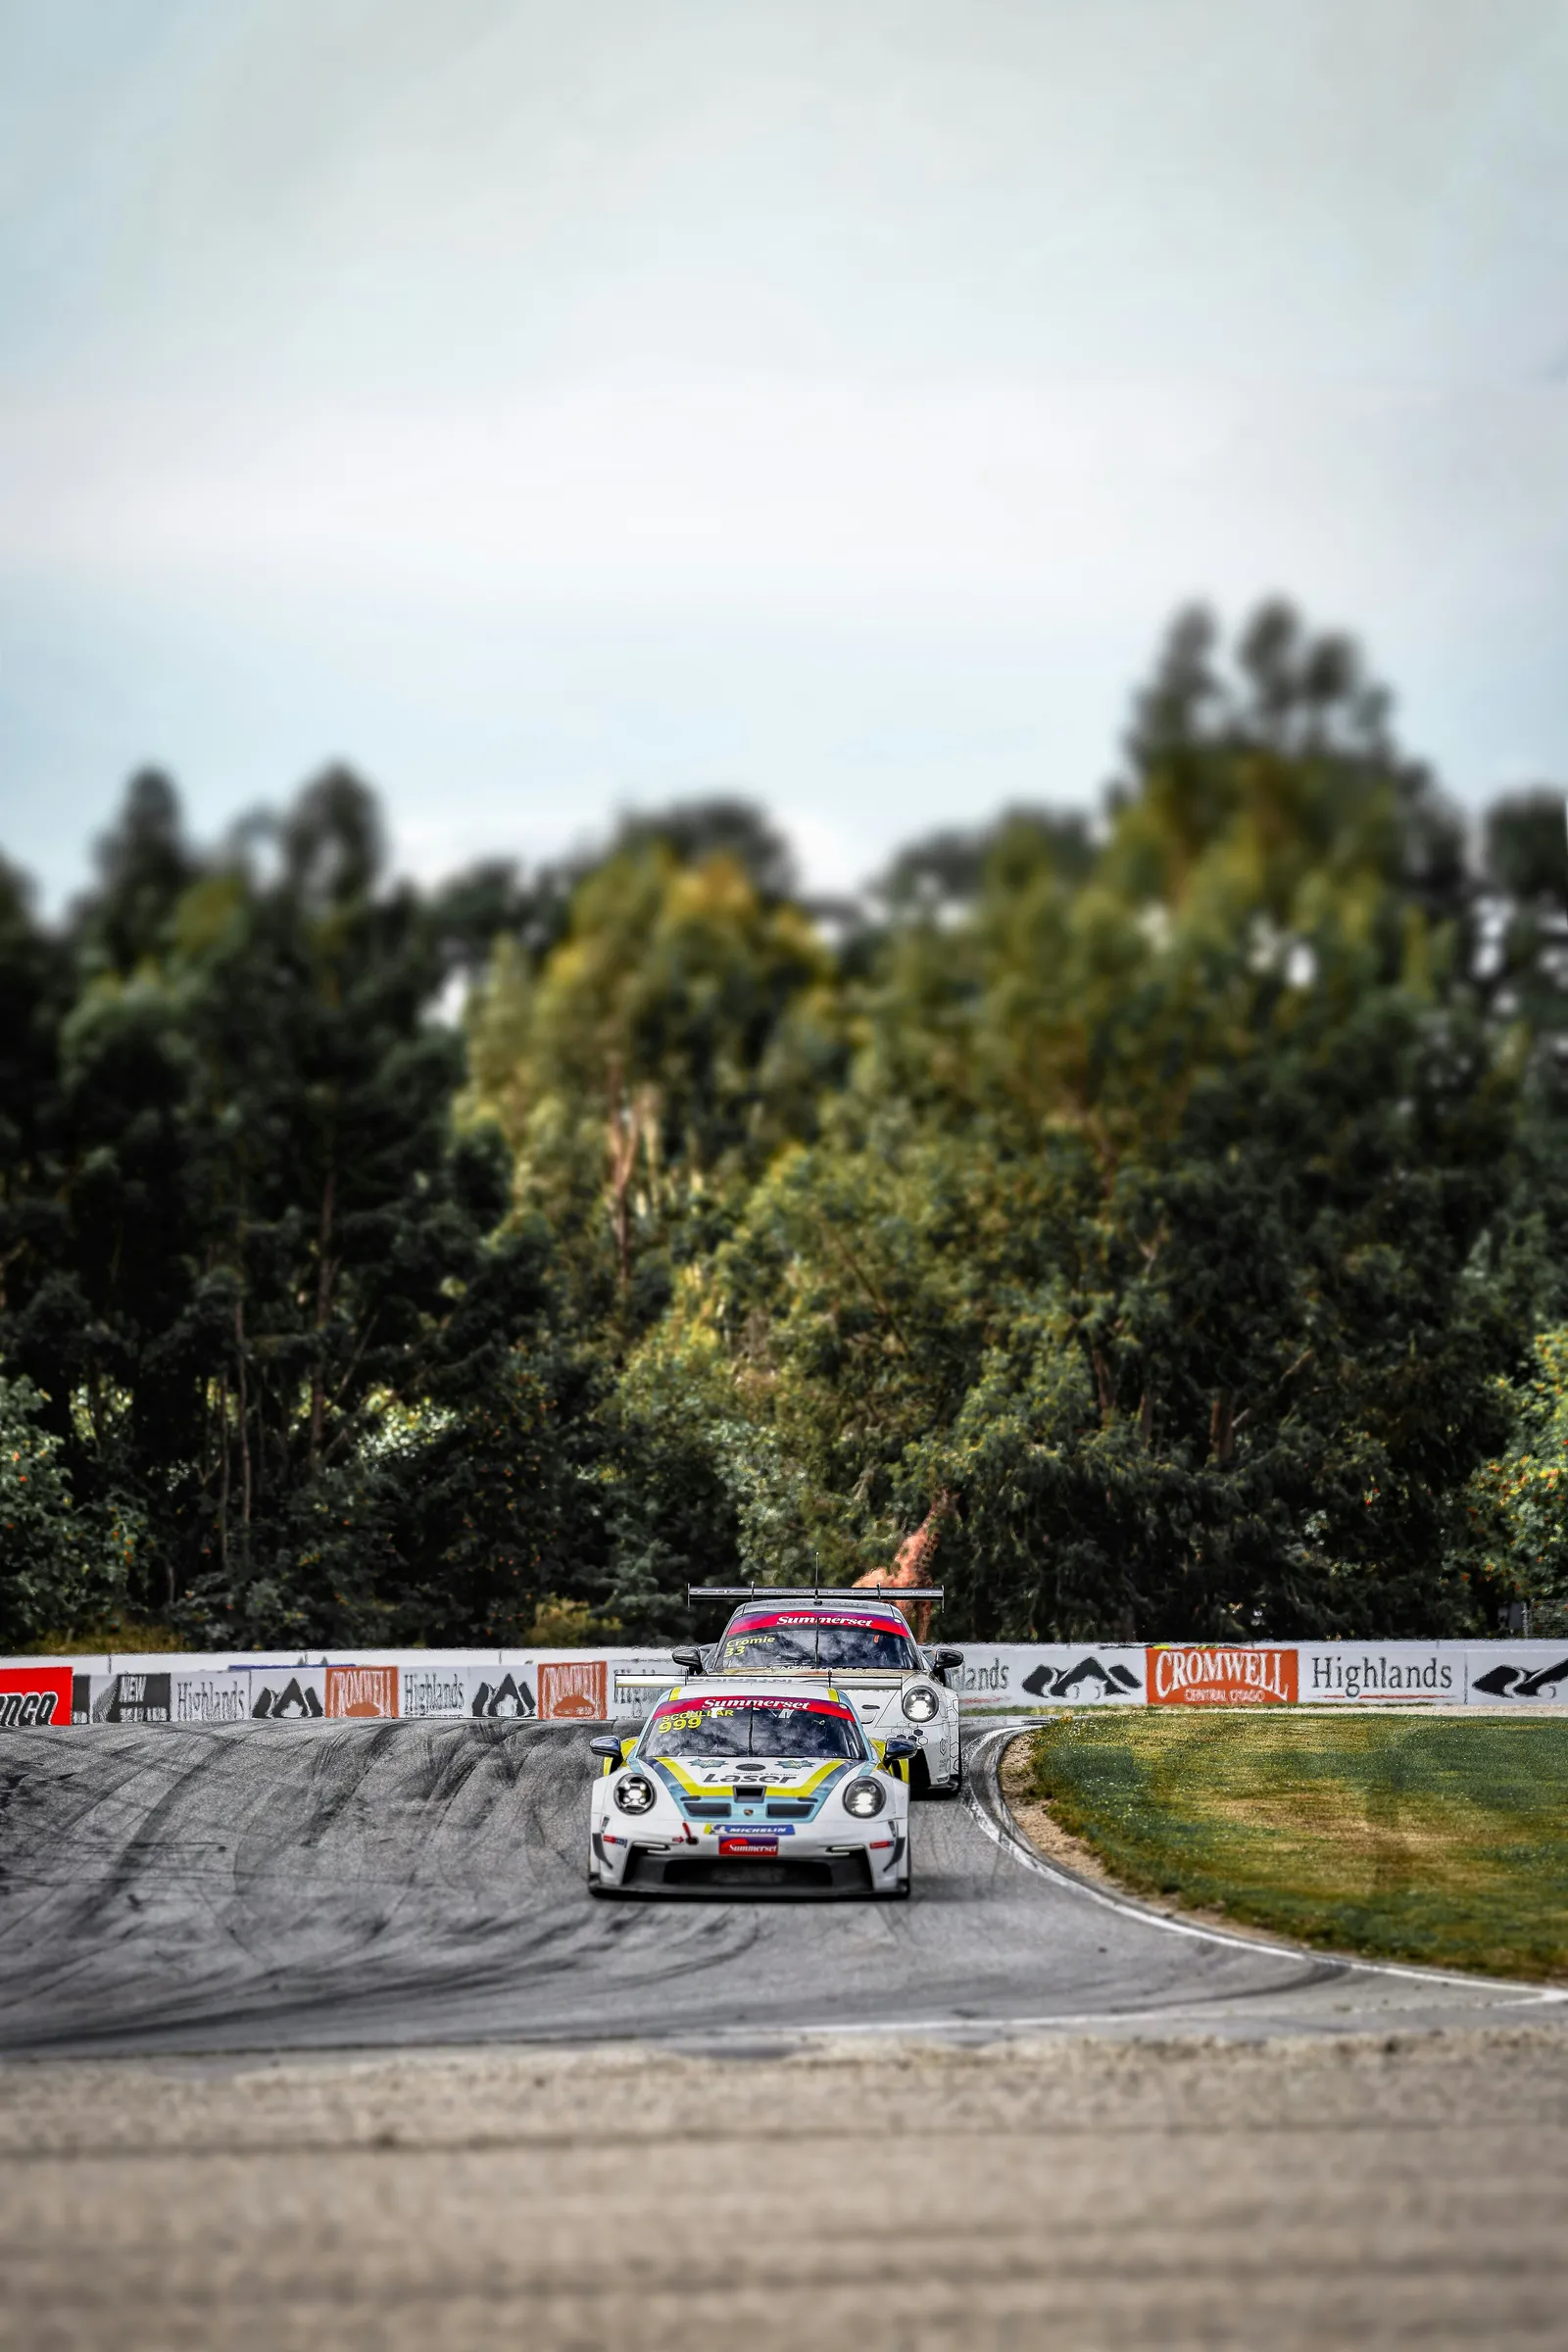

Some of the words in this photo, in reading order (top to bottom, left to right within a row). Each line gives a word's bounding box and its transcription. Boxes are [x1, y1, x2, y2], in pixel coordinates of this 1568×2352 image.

[776, 1616, 873, 1627] Summerset
[726, 1636, 775, 1648] Cromie
[723, 1646, 745, 1658] 33
[1155, 1651, 1289, 1701] CROMWELL
[1311, 1656, 1453, 1697] Highlands
[702, 1698, 811, 1710] Summerset
[659, 1717, 702, 1734] 999
[703, 1773, 798, 1784] Laser
[728, 1842, 778, 1853] Summerset
